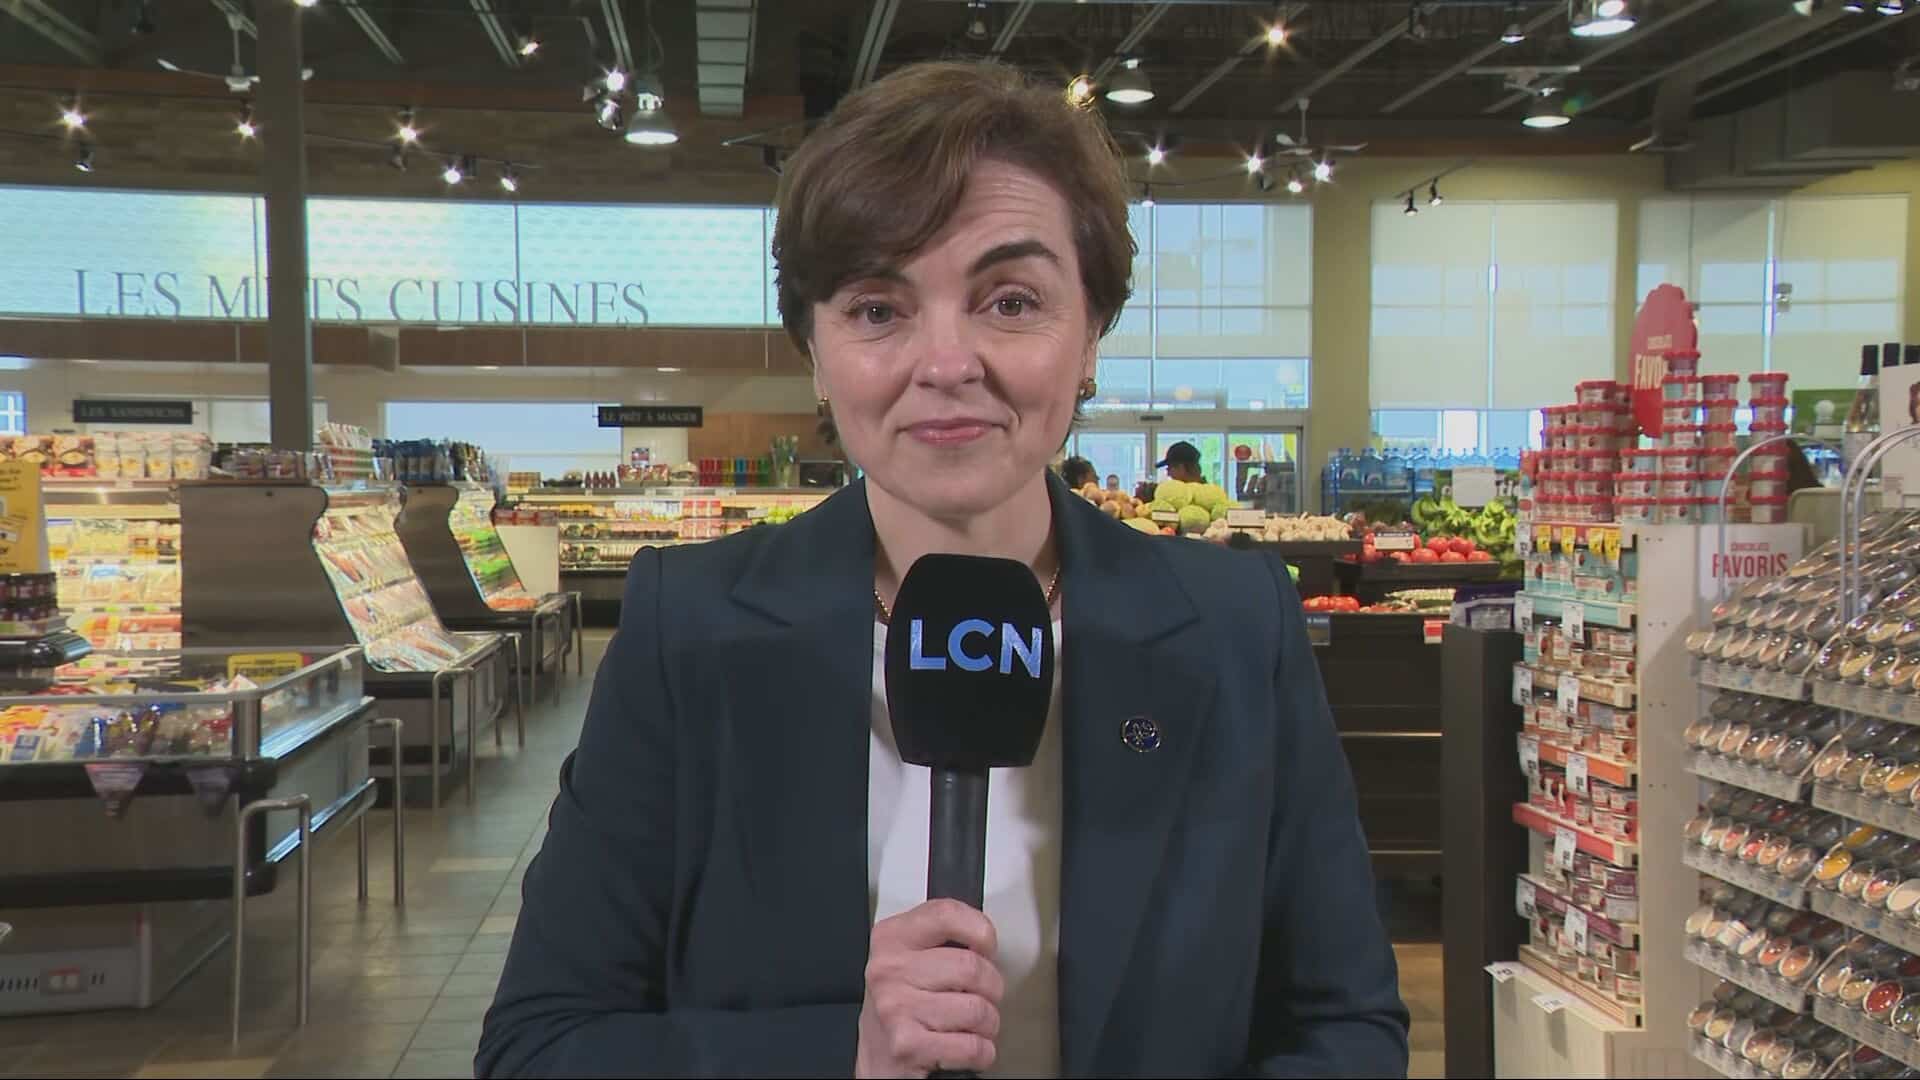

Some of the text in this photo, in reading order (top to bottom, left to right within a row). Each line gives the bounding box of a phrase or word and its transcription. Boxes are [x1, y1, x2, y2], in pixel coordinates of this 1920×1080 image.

[73, 269, 181, 319] LES
[207, 273, 362, 320] MTS
[1634, 352, 1669, 390] FAVO
[1711, 552, 1788, 578] FAVORIS
[910, 618, 1043, 679] LCN
